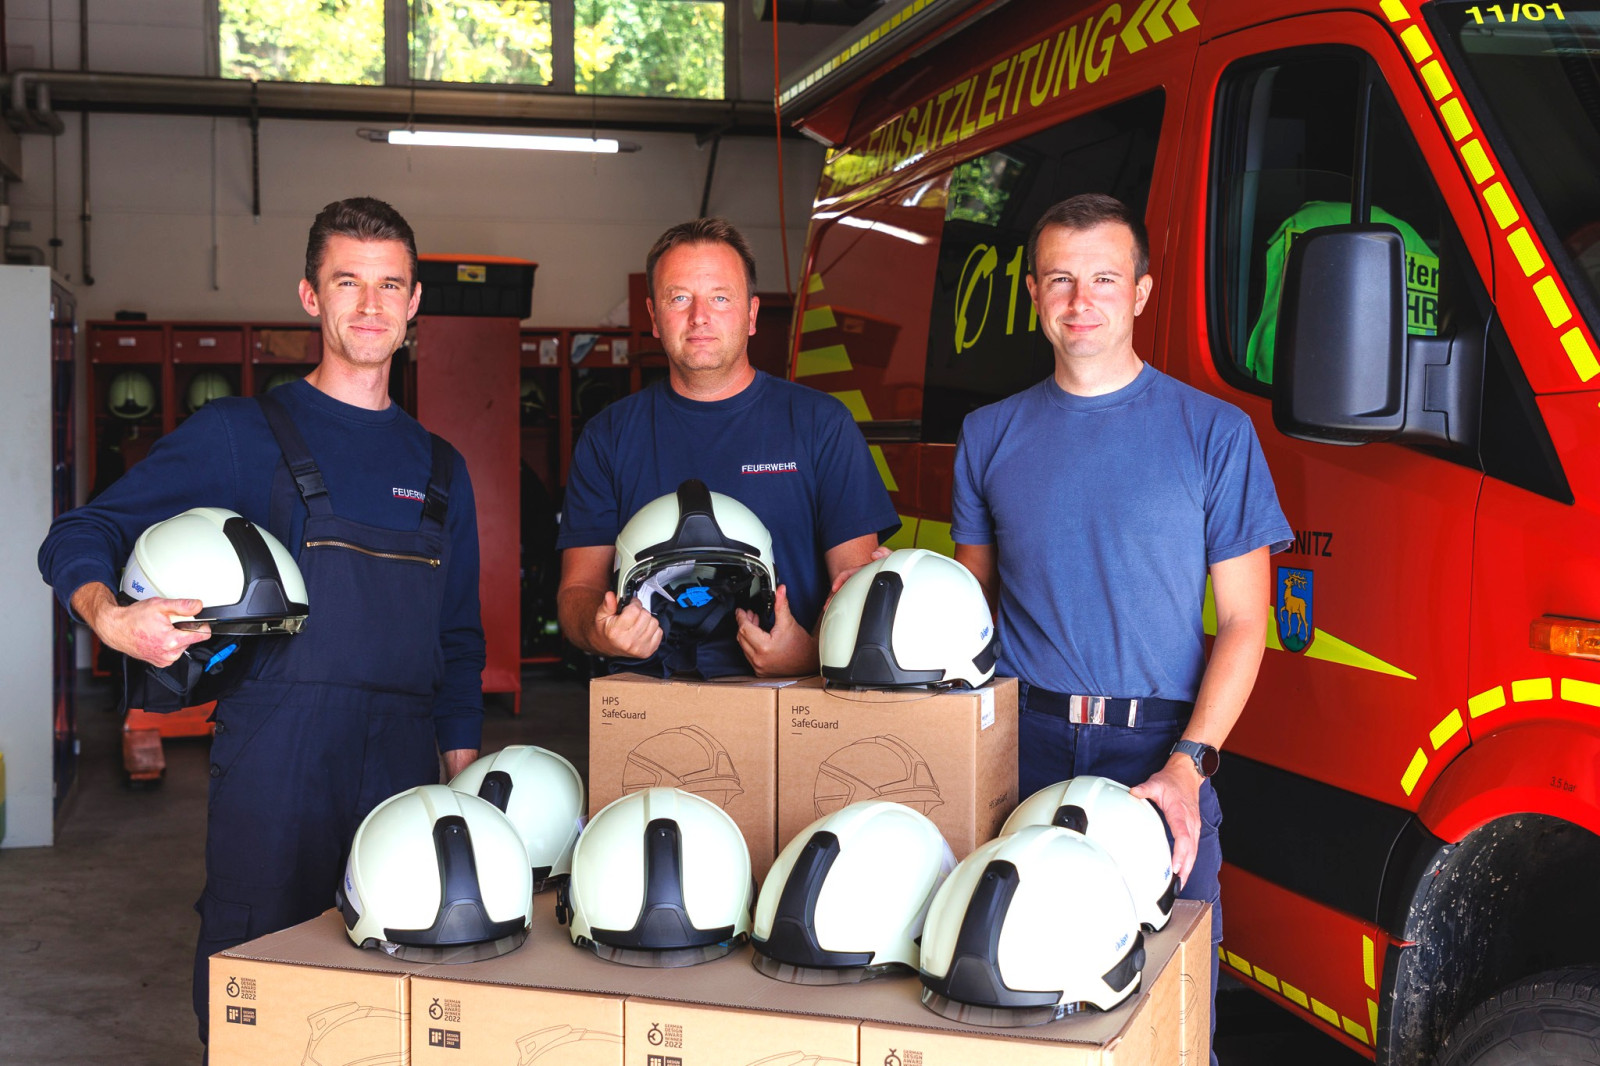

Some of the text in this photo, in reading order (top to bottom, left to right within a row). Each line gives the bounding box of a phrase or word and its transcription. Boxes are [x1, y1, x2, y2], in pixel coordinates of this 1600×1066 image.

[1465, 3, 1565, 25] 11/01
[862, 3, 1122, 178] EINSATZLEITUNG
[1405, 256, 1439, 288] ter
[741, 461, 797, 473] FEUERWEHR
[1284, 530, 1333, 557] NITZ
[601, 696, 620, 706] HPS
[601, 708, 647, 720] SafeGuard
[791, 705, 811, 715] HPS
[791, 718, 839, 730] SafeGuard
[664, 1040, 682, 1048] 2022
